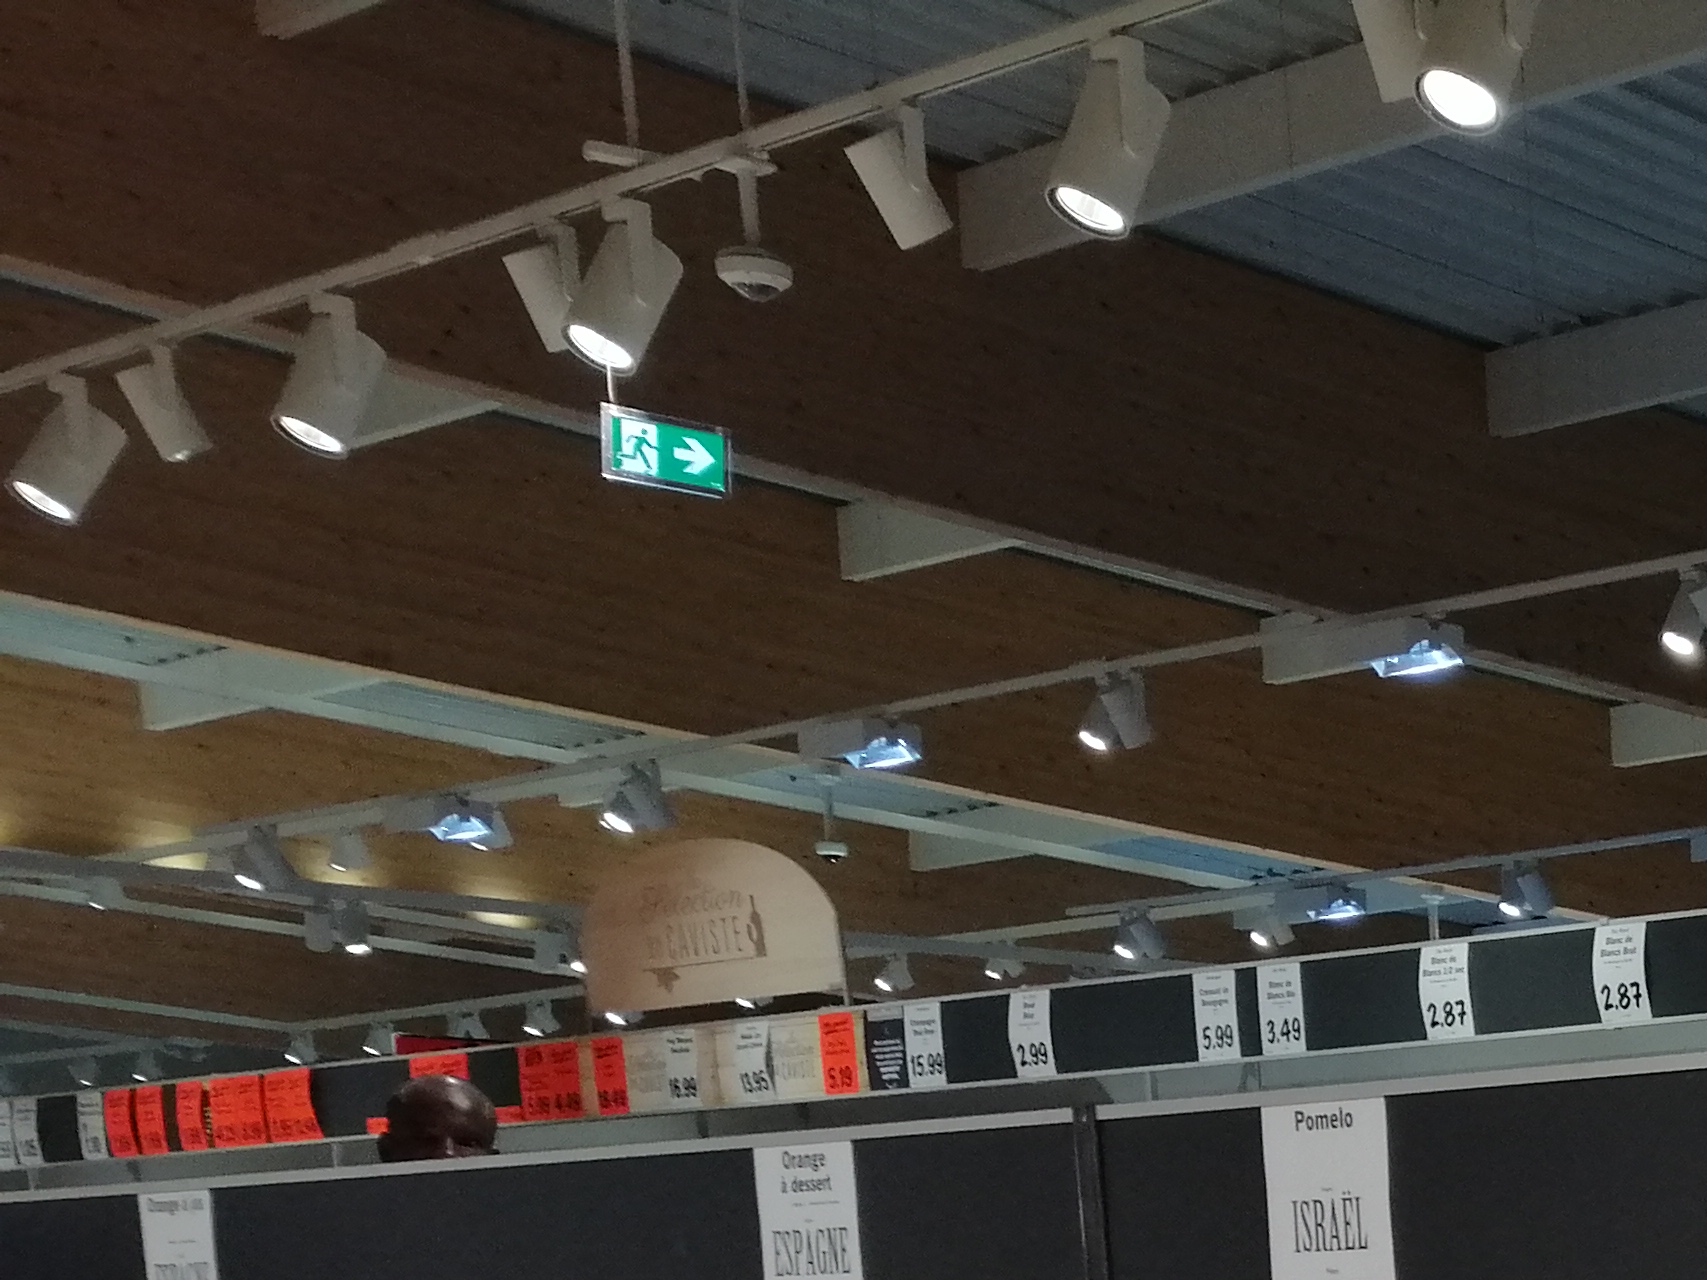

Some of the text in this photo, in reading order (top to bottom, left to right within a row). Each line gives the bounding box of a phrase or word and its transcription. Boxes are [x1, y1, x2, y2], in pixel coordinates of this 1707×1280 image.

[1600, 981, 1643, 1011] 2.87
[1427, 1000, 1467, 1028] 2.87
[1202, 1024, 1234, 1050] 5.99
[1267, 1017, 1301, 1044] 3.49
[911, 1053, 944, 1077] 15.99
[1017, 1042, 1048, 1068] 2.99
[1294, 1107, 1353, 1131] Pomelo
[781, 1149, 826, 1172] Orange
[781, 1172, 832, 1193] à dessert
[1291, 1189, 1368, 1253] ISRAËL
[772, 1226, 851, 1278] ESPAGNE
